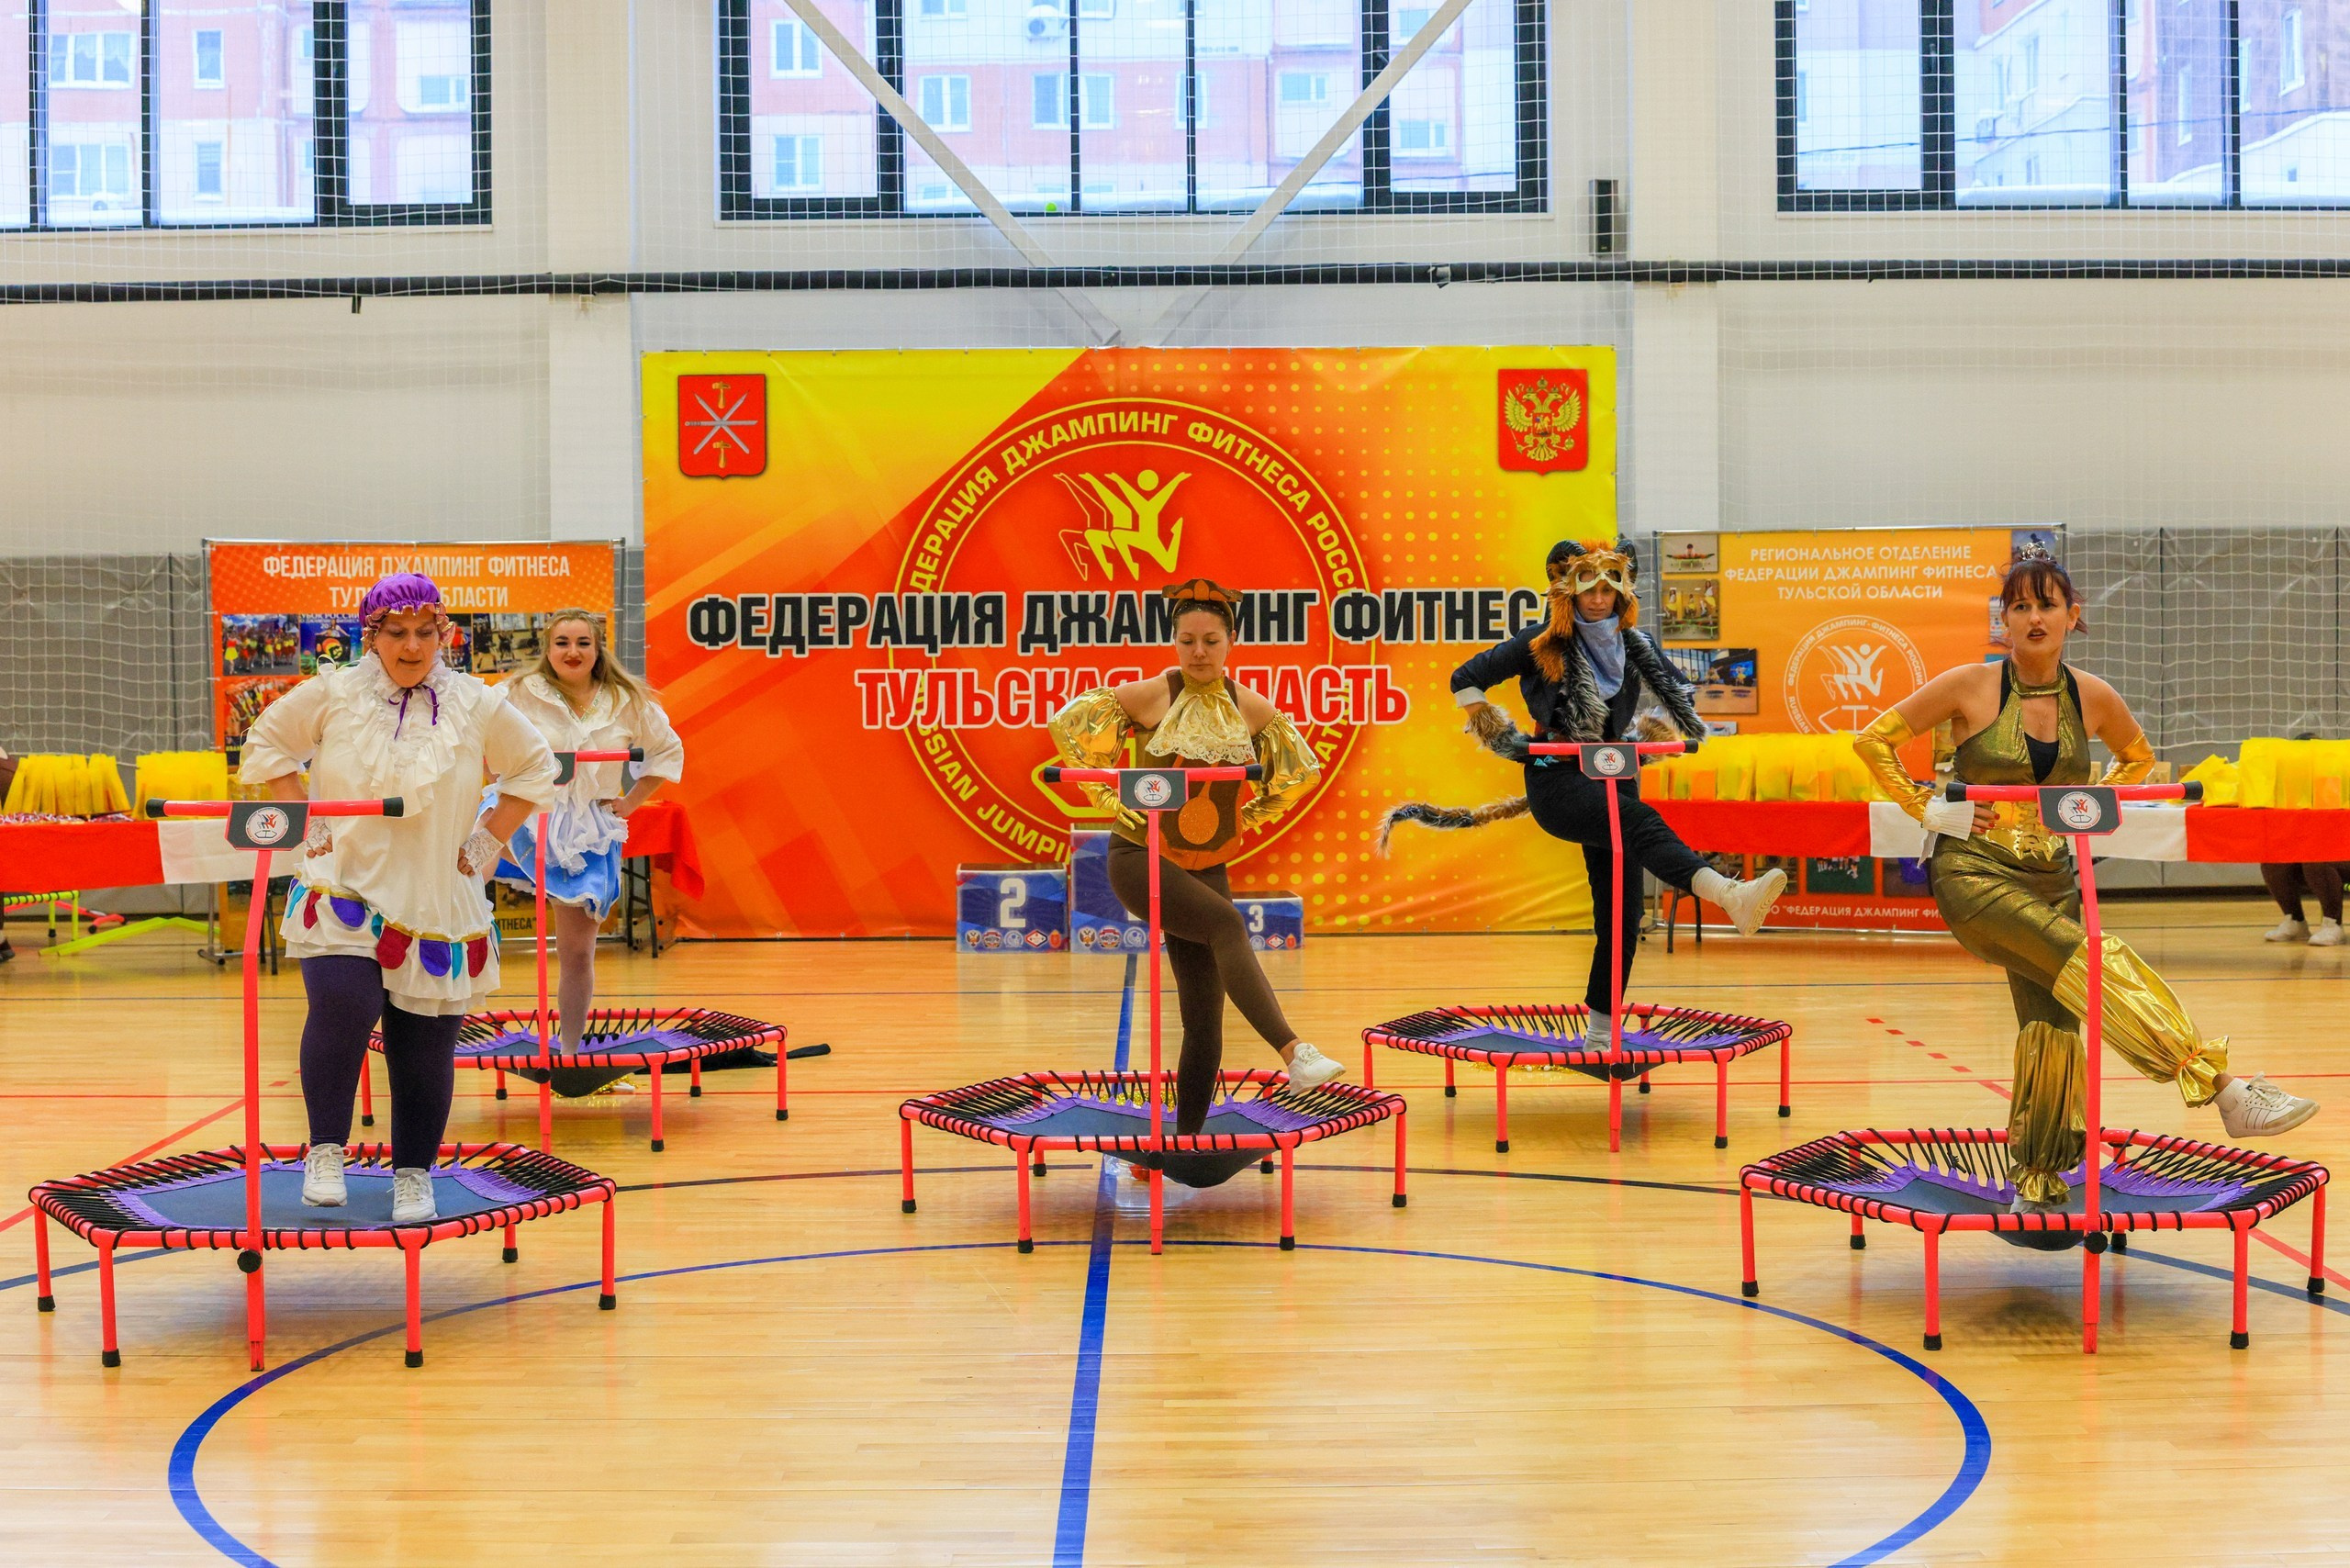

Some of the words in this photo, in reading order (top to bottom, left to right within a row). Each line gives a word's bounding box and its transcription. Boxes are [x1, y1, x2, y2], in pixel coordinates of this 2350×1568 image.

[909, 465, 999, 592] ДЕРАЦИЯ
[1001, 410, 1179, 476] ДЖАМПИНГ
[1187, 420, 1311, 512] ФИТНЕСА
[1306, 511, 1358, 594] РОСС
[1751, 546, 1874, 562] РЕГИОНАЛЬНОЕ
[1879, 545, 1972, 561] ОТДЕЛЕНИЕ
[263, 555, 375, 579] ФЕДЕРАЦИЯ
[379, 555, 484, 579] ДЖАМПИНГ
[487, 555, 570, 577] ФИТНЕСА
[1724, 567, 1819, 581] ФЕДЕРАЦИИ
[1824, 566, 1919, 581] ДЖАМПИНГ
[1922, 565, 1998, 579] ФИТНЕСА
[443, 587, 509, 608] БЛАСТИ
[1777, 583, 1861, 600] ТУЛЬСКОЙ
[1865, 585, 1943, 599] ОБЛАСТИ
[688, 591, 1006, 656] ФЕДЕРАЦИЯ
[1017, 589, 1319, 656] ДЖАМИНГ
[1331, 587, 1551, 644] ФИТНЕС
[1788, 637, 1816, 687] ФЕДЕРАЦИЯ
[1907, 649, 1924, 686] РОССИИ
[977, 803, 1071, 865] JUMPI
[1000, 878, 1026, 928] 2
[1853, 906, 1919, 918] ДЖАМПИНГ
[1248, 905, 1264, 932] 3
